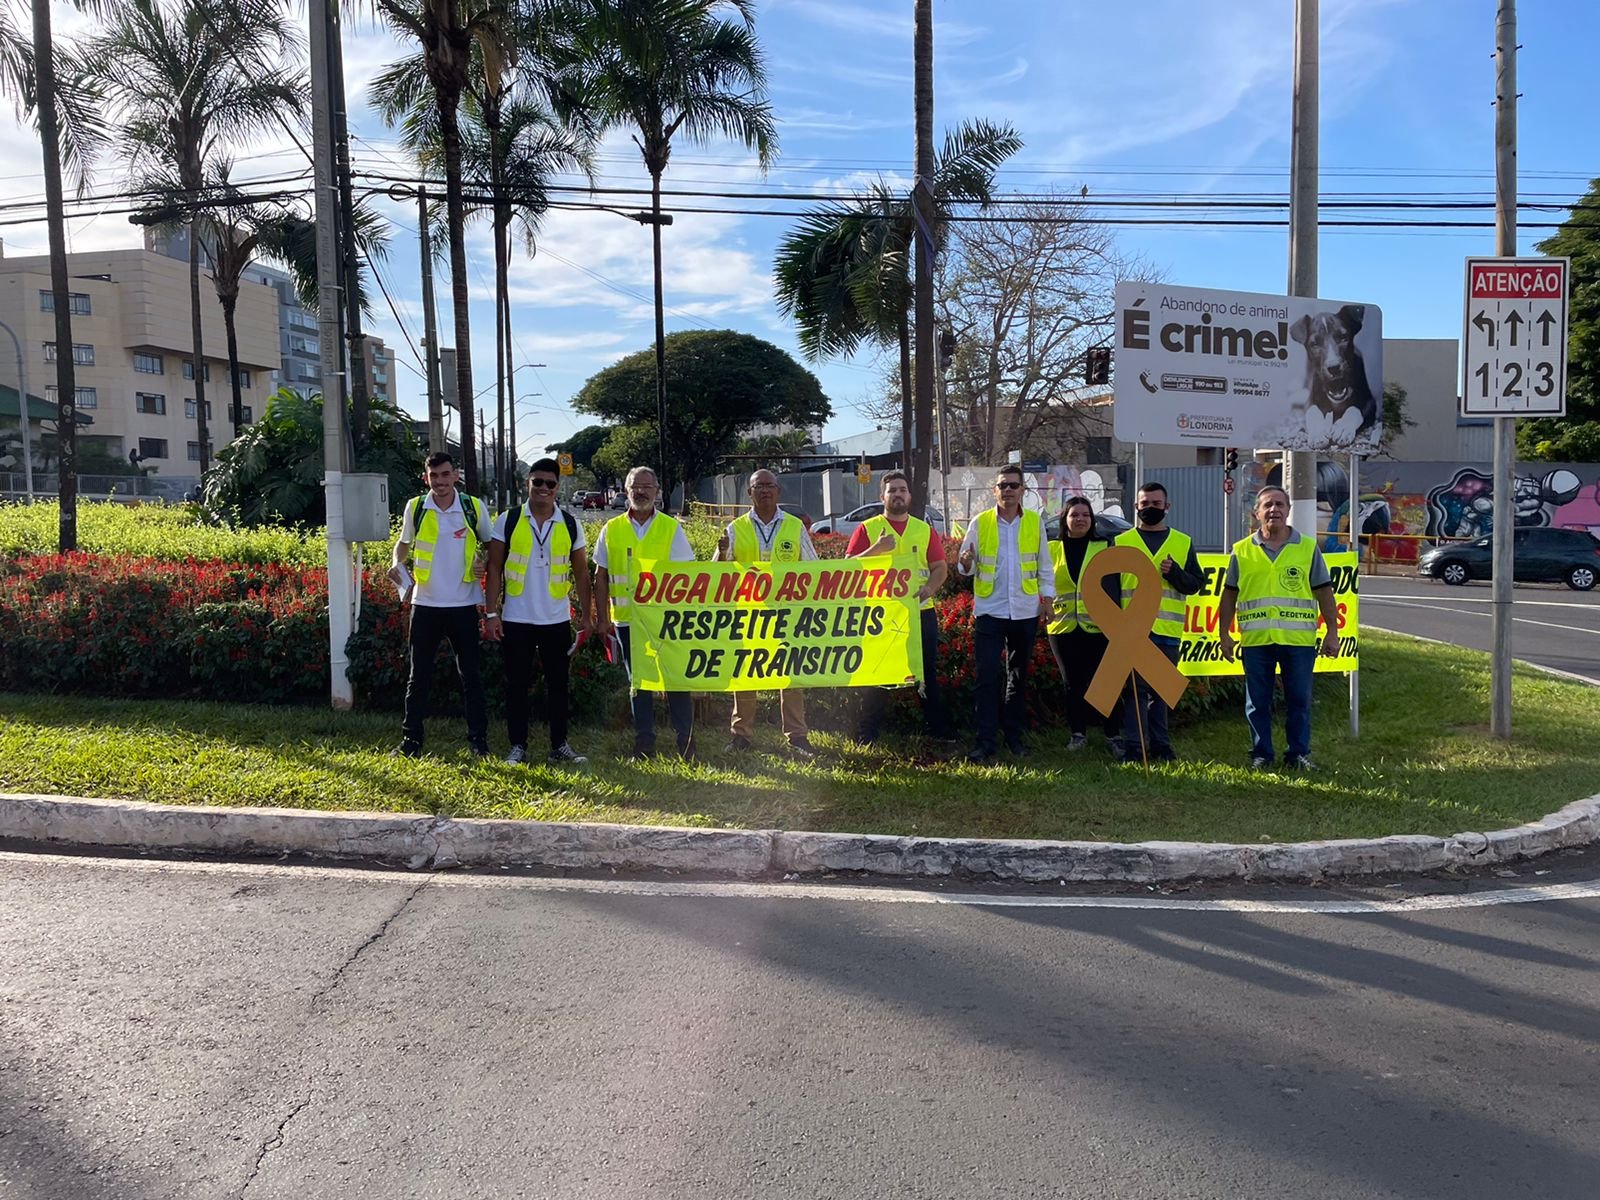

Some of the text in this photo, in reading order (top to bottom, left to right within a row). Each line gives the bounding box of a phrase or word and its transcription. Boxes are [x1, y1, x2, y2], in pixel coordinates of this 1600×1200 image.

[1474, 268, 1559, 297] ATENÇÃO
[1160, 296, 1288, 320] Abandono de animal
[1123, 298, 1288, 361] É crime!
[1475, 361, 1555, 397] 1 2 3
[1190, 421, 1233, 431] LONDRINA
[633, 566, 912, 604] DIGA NÃO AS MULTAS
[659, 606, 885, 641] RESPEITE AS LEIS
[1280, 610, 1315, 619] CEDETRAN
[685, 642, 863, 678] DE TRÂNSITO
